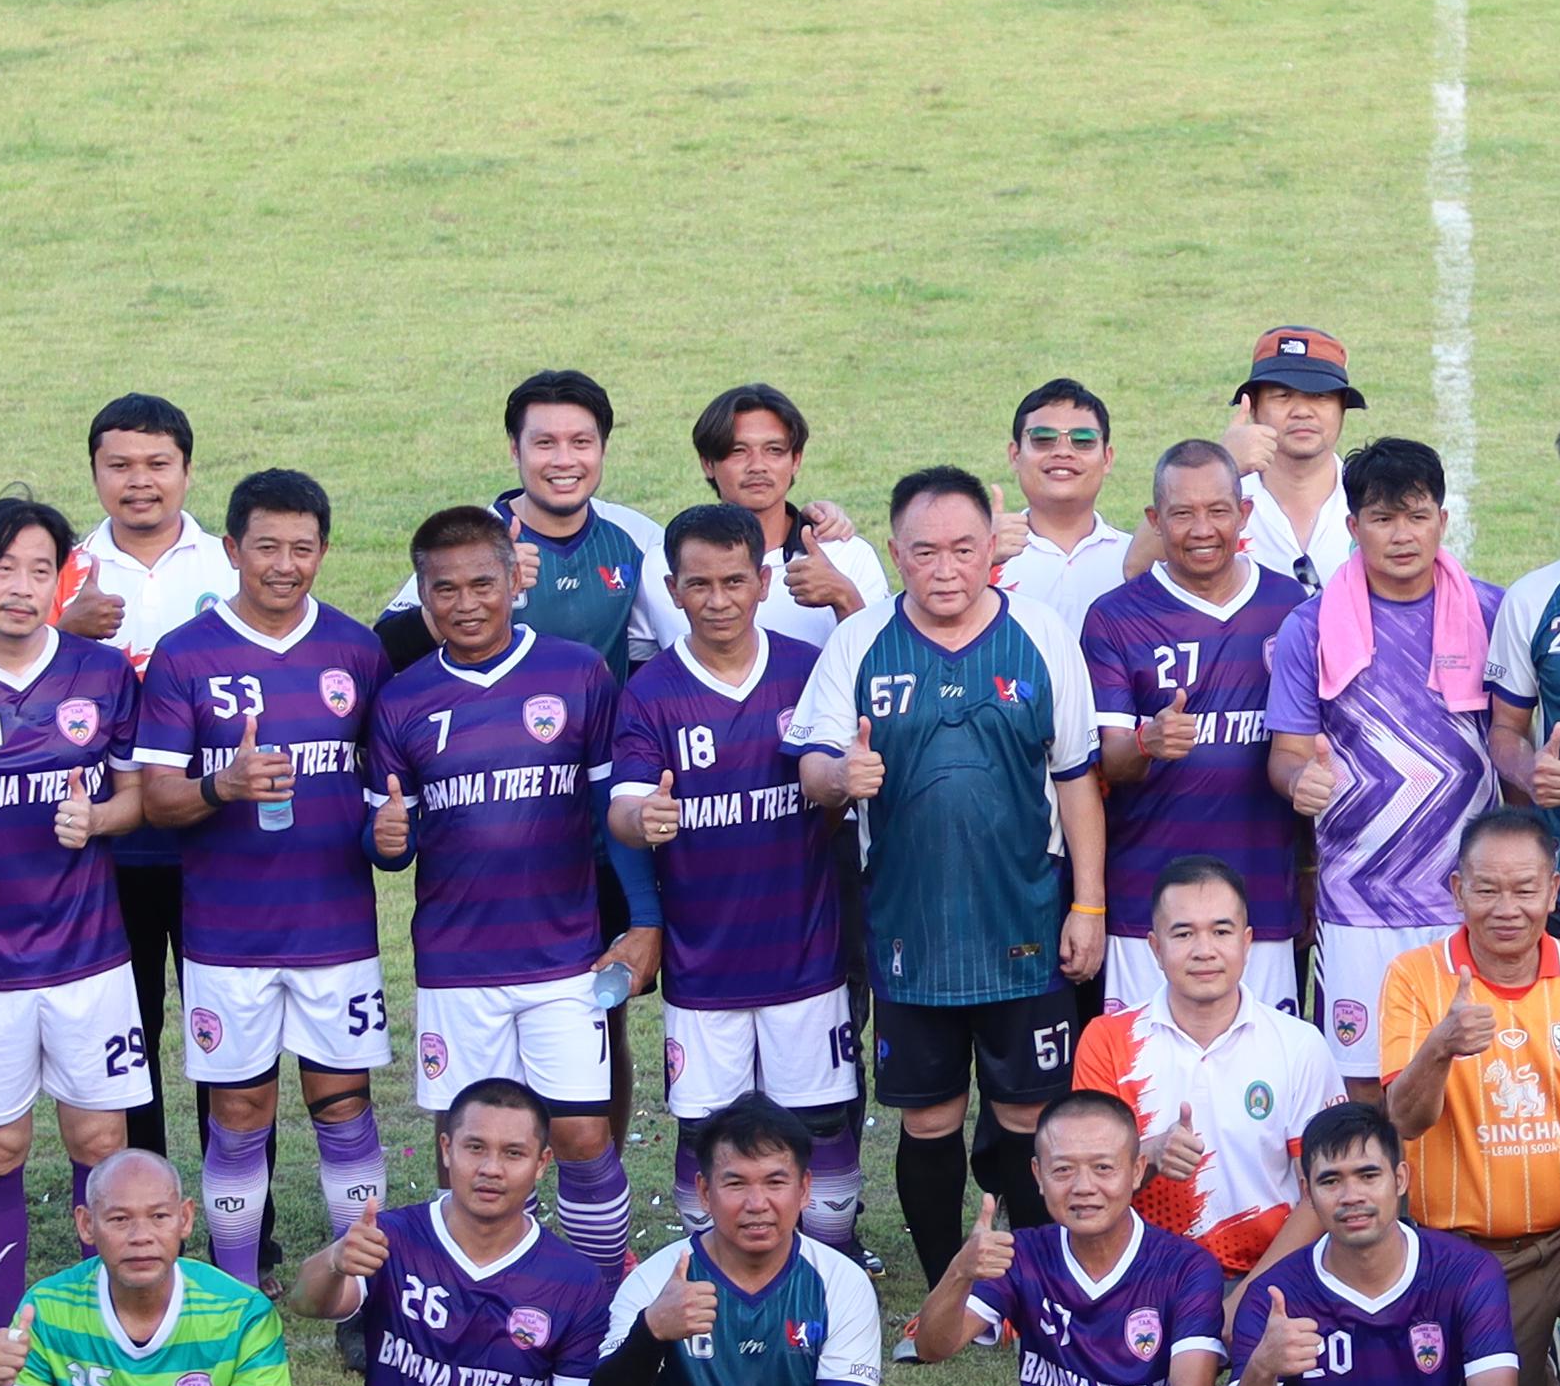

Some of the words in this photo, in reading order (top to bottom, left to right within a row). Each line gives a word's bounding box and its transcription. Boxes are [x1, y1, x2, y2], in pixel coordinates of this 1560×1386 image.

[1154, 642, 1200, 689] 27
[209, 674, 265, 720] 53
[870, 674, 916, 717] 57
[428, 709, 453, 754] 7
[677, 724, 717, 772] 18
[290, 742, 339, 777] TREE
[492, 765, 545, 802] TREE
[748, 782, 801, 823] TREE
[348, 988, 388, 1037] 53
[105, 1027, 147, 1078] 29
[593, 1021, 606, 1065] 7
[828, 1020, 857, 1070] 18
[1034, 1020, 1071, 1071] 57
[1491, 1145, 1528, 1157] LEMON
[1530, 1143, 1558, 1154] SODA
[401, 1273, 450, 1330] 26
